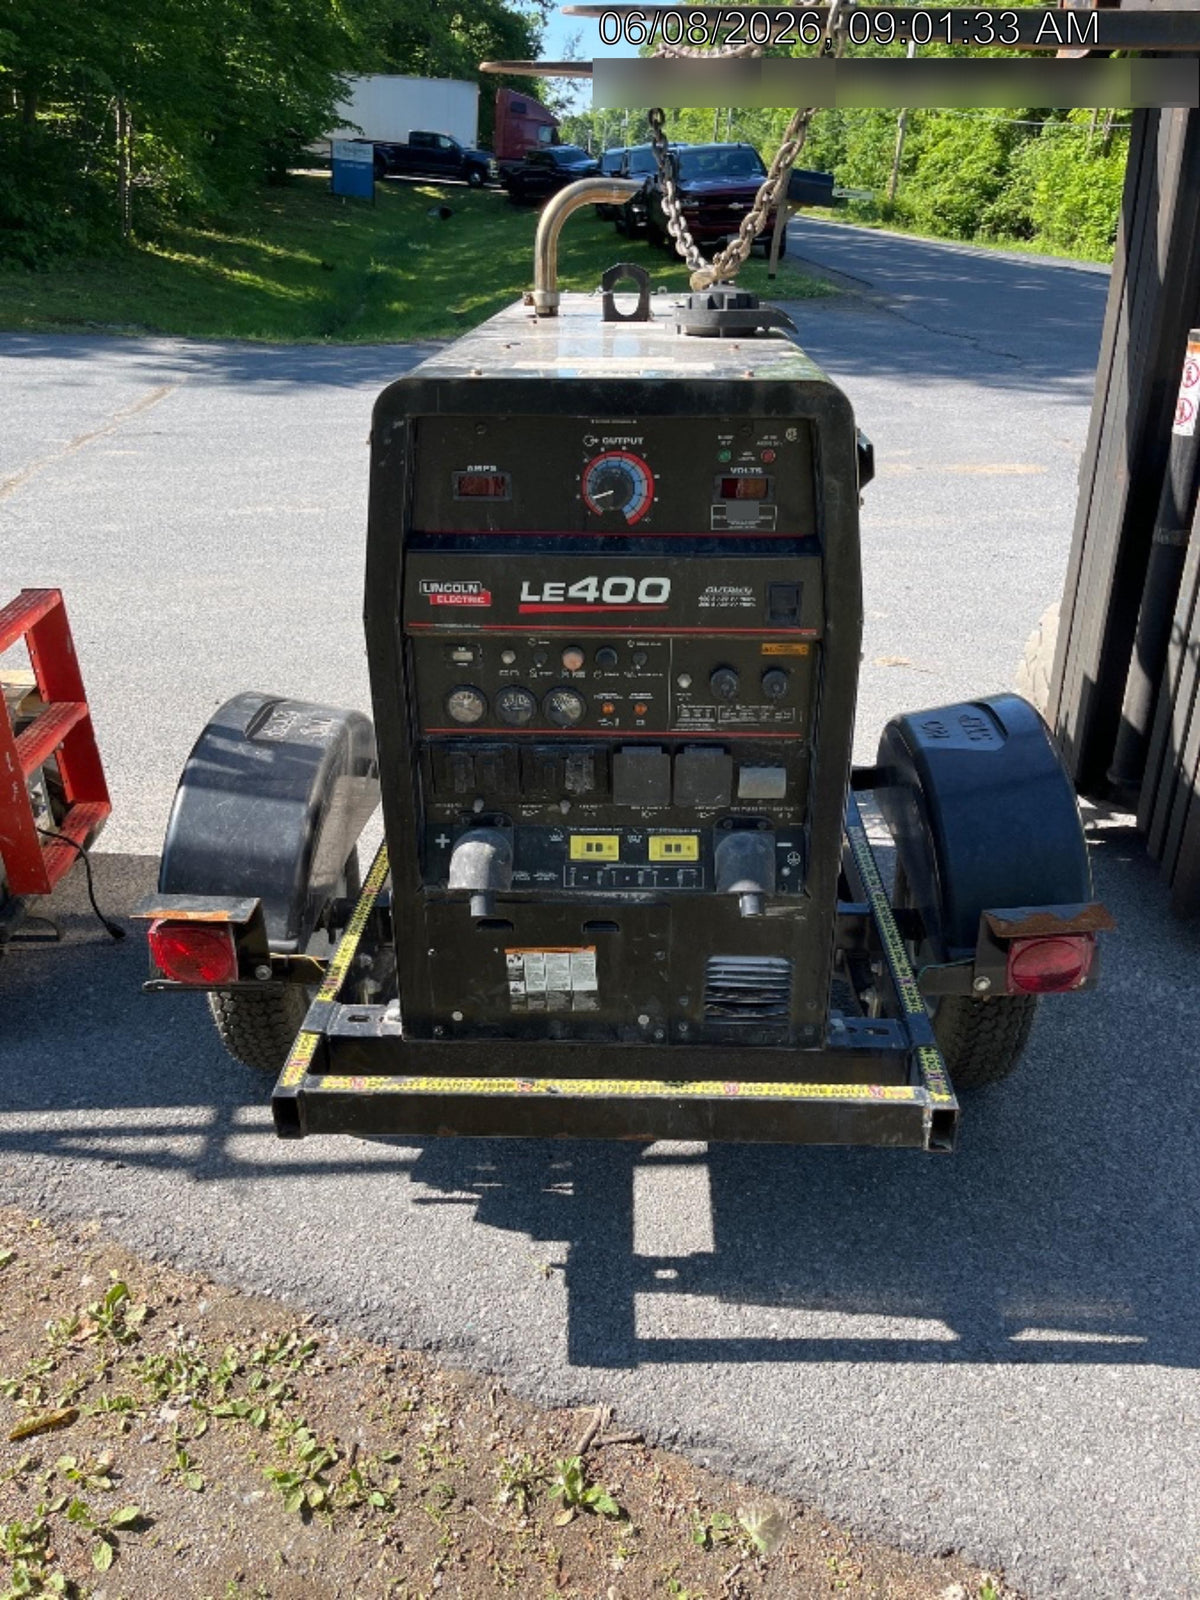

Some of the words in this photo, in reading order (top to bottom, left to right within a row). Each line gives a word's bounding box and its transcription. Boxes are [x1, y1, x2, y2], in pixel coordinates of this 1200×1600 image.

[602, 437, 644, 445] OUTPUT
[422, 582, 479, 593] LINCOLN
[519, 576, 672, 604] LE400
[436, 595, 486, 604] ELECTRIC
